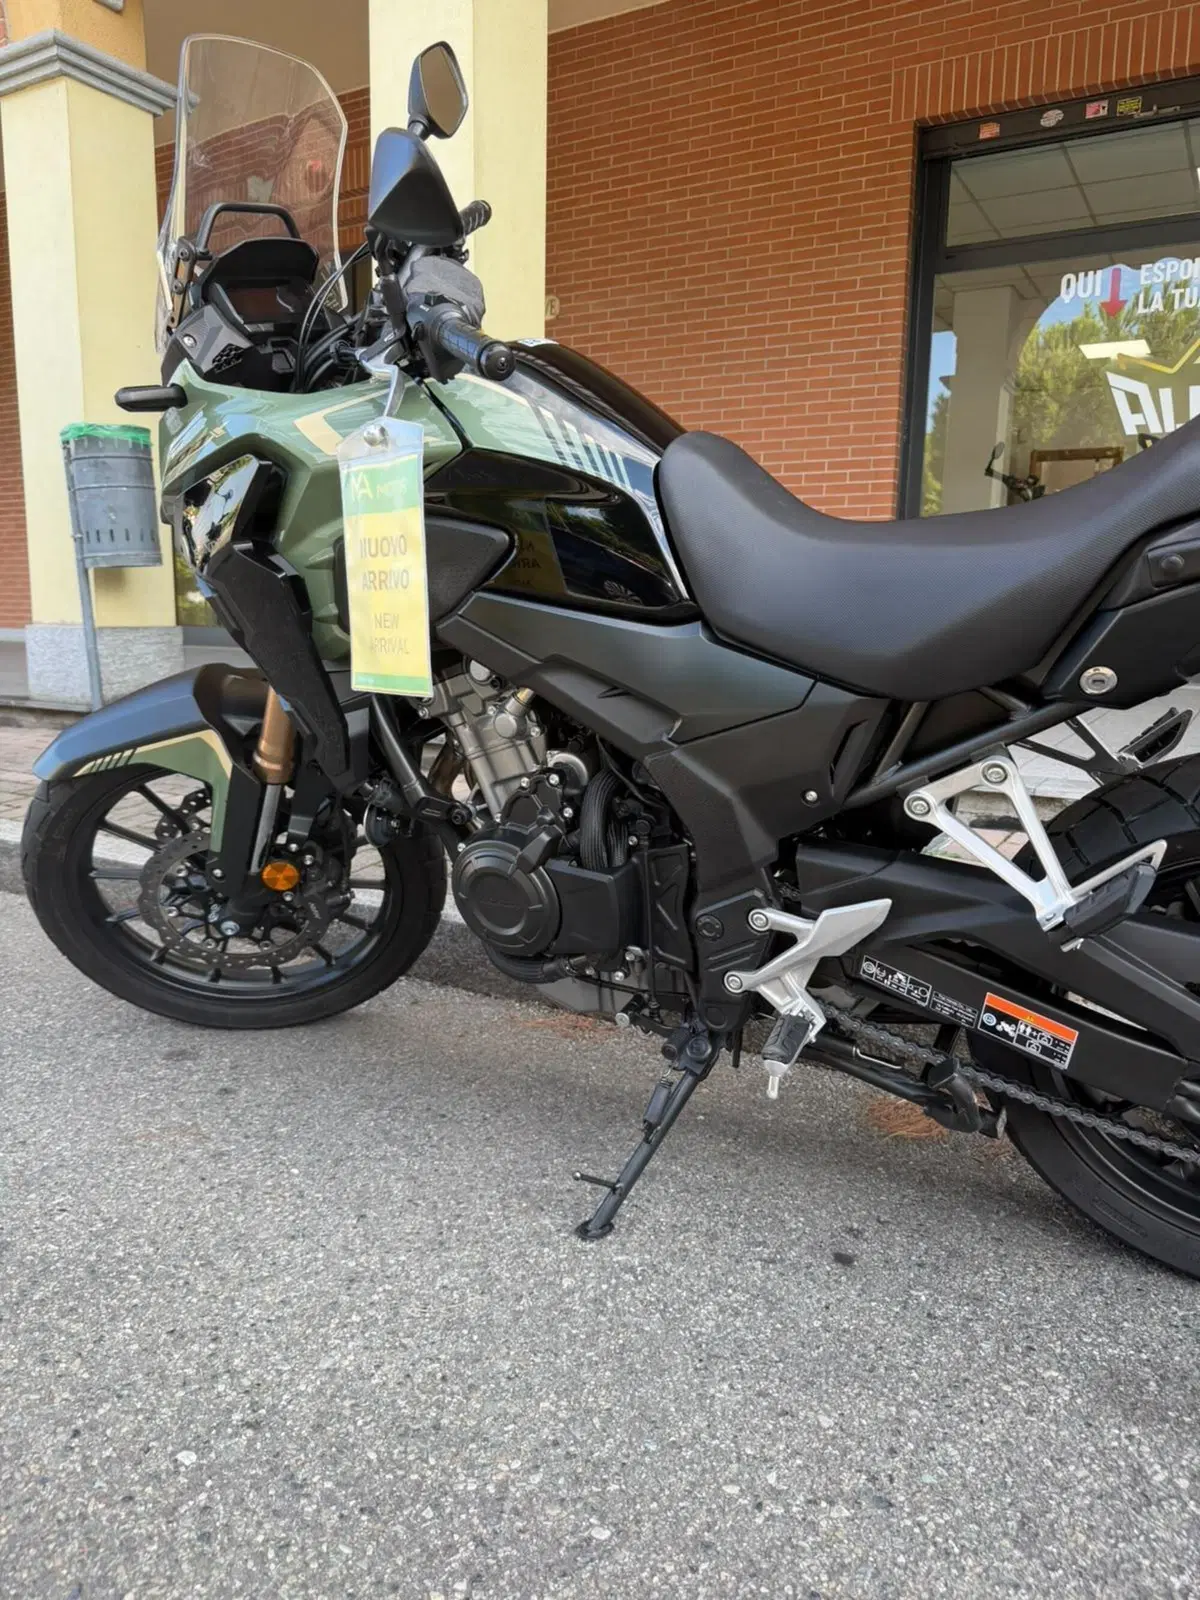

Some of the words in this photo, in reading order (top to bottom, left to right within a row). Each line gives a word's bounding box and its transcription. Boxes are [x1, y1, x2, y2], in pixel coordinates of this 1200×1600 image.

[1060, 270, 1103, 304] QUI
[1137, 290, 1164, 314] LA
[1171, 286, 1200, 310] TU
[359, 535, 408, 559] NUOVO
[362, 569, 410, 592] ARRIVO
[374, 612, 400, 629] NEW
